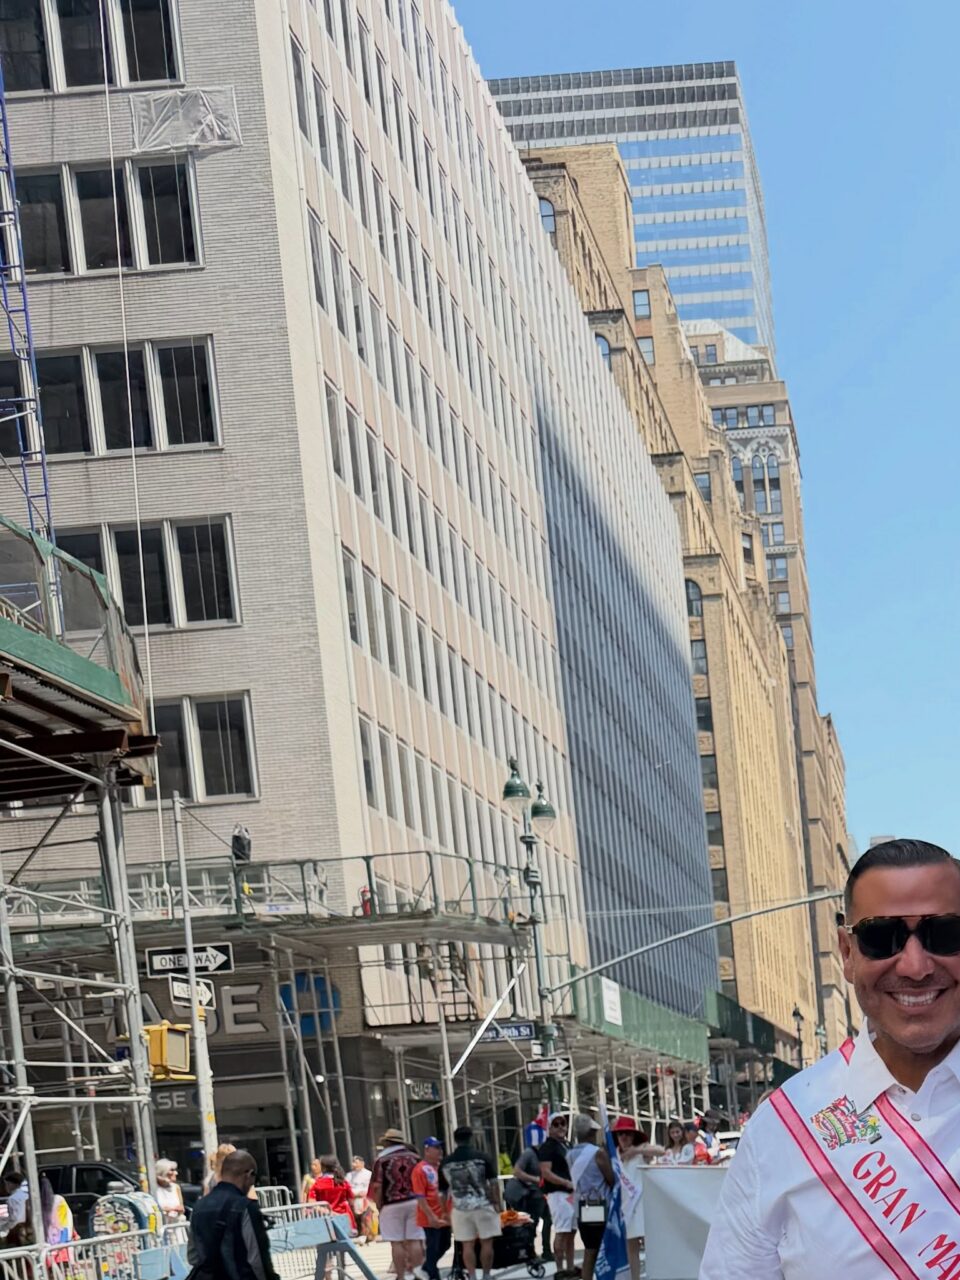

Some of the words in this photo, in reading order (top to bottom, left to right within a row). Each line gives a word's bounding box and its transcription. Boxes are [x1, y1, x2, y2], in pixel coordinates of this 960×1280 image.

[159, 956, 184, 967] ONE
[194, 953, 219, 964] WAY
[520, 1026, 530, 1036] St
[852, 1150, 927, 1234] GRAN
